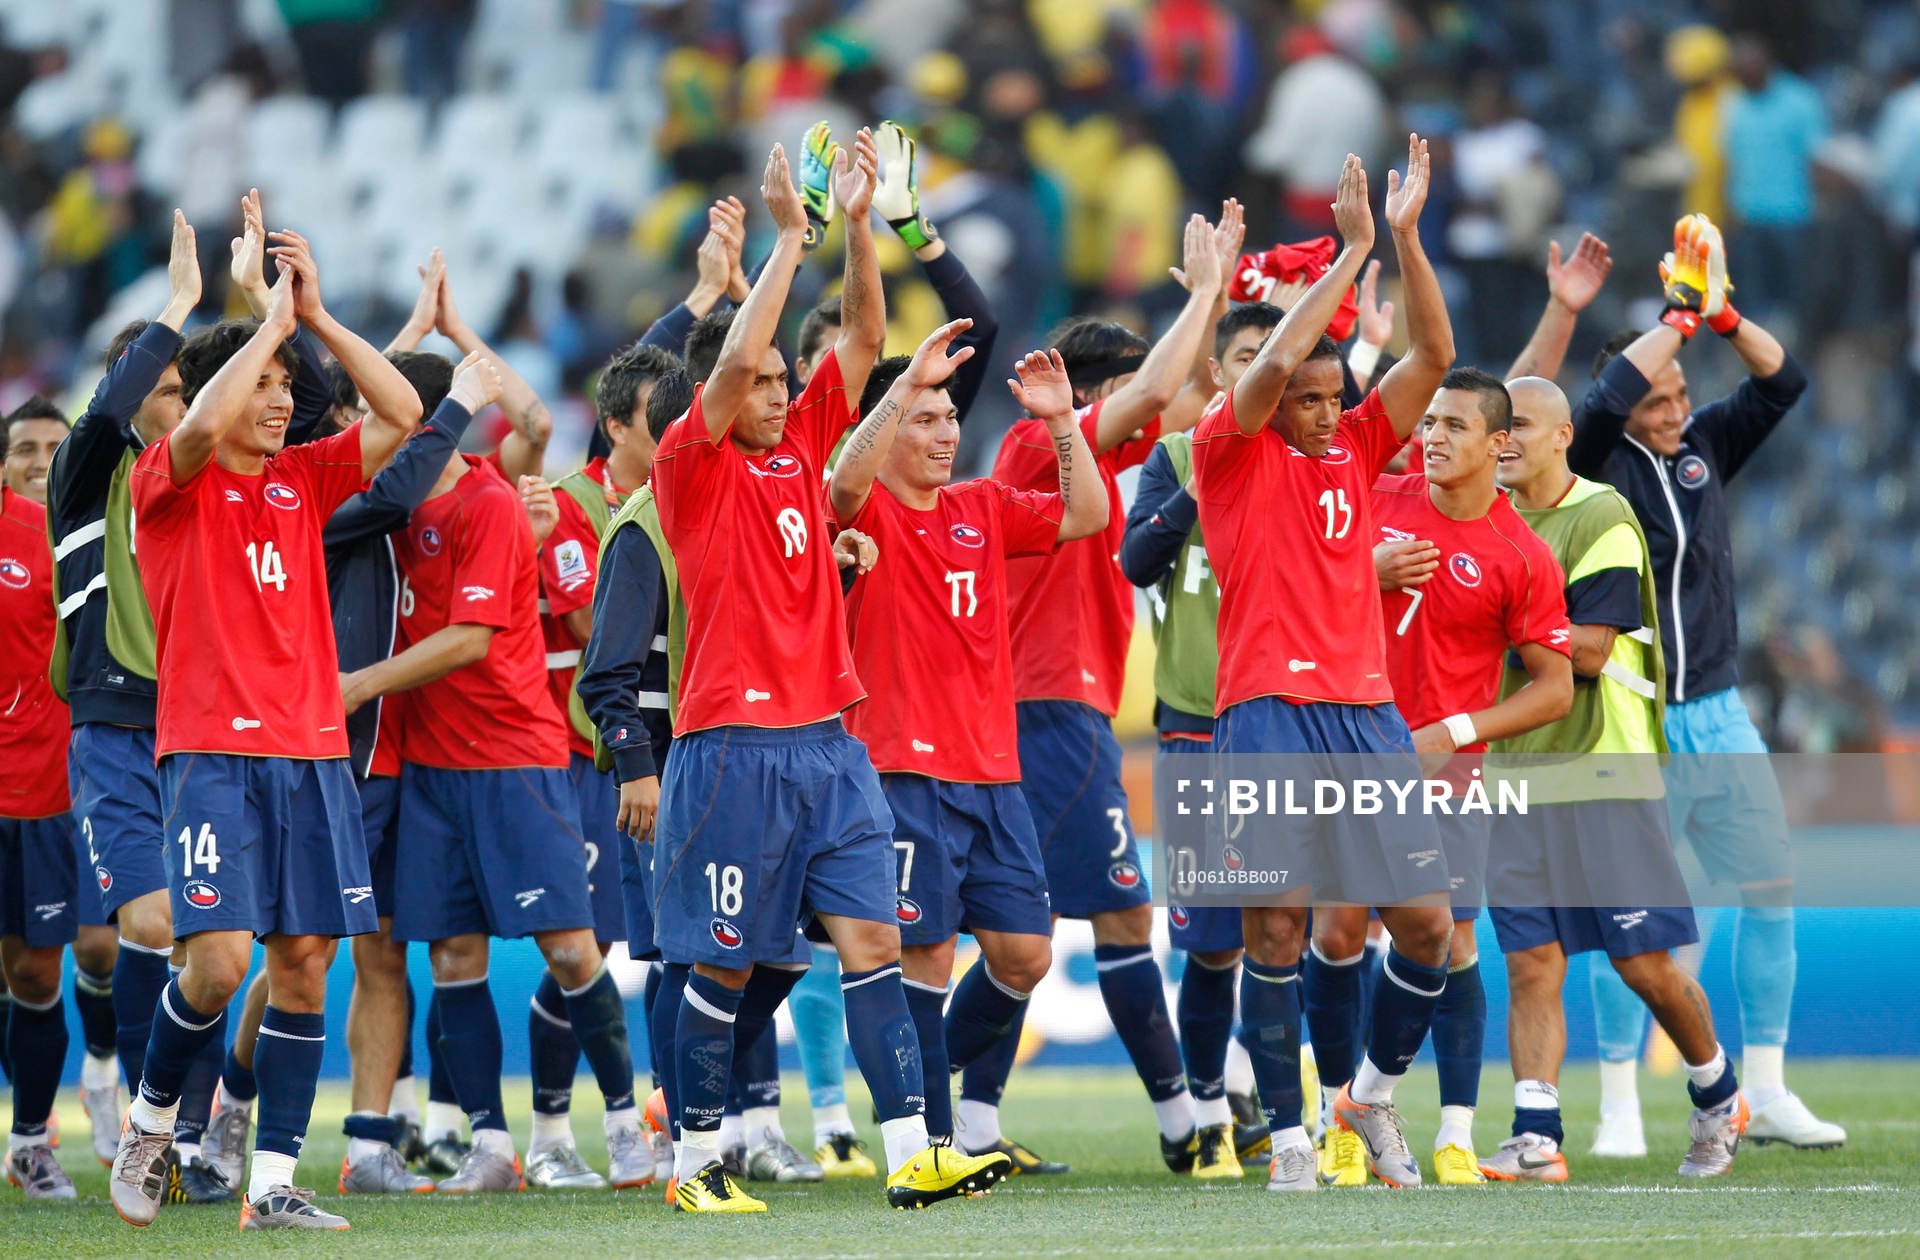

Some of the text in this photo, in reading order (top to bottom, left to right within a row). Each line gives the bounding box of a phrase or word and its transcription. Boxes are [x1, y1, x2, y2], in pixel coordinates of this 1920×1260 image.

[775, 507, 807, 558] 18
[1318, 488, 1350, 539] 15
[246, 541, 288, 593] 14
[944, 571, 977, 617] 17
[1397, 587, 1423, 635] 7
[178, 822, 221, 877] 14
[1107, 808, 1128, 858] 3
[705, 862, 744, 916] 18
[894, 841, 916, 892] 7
